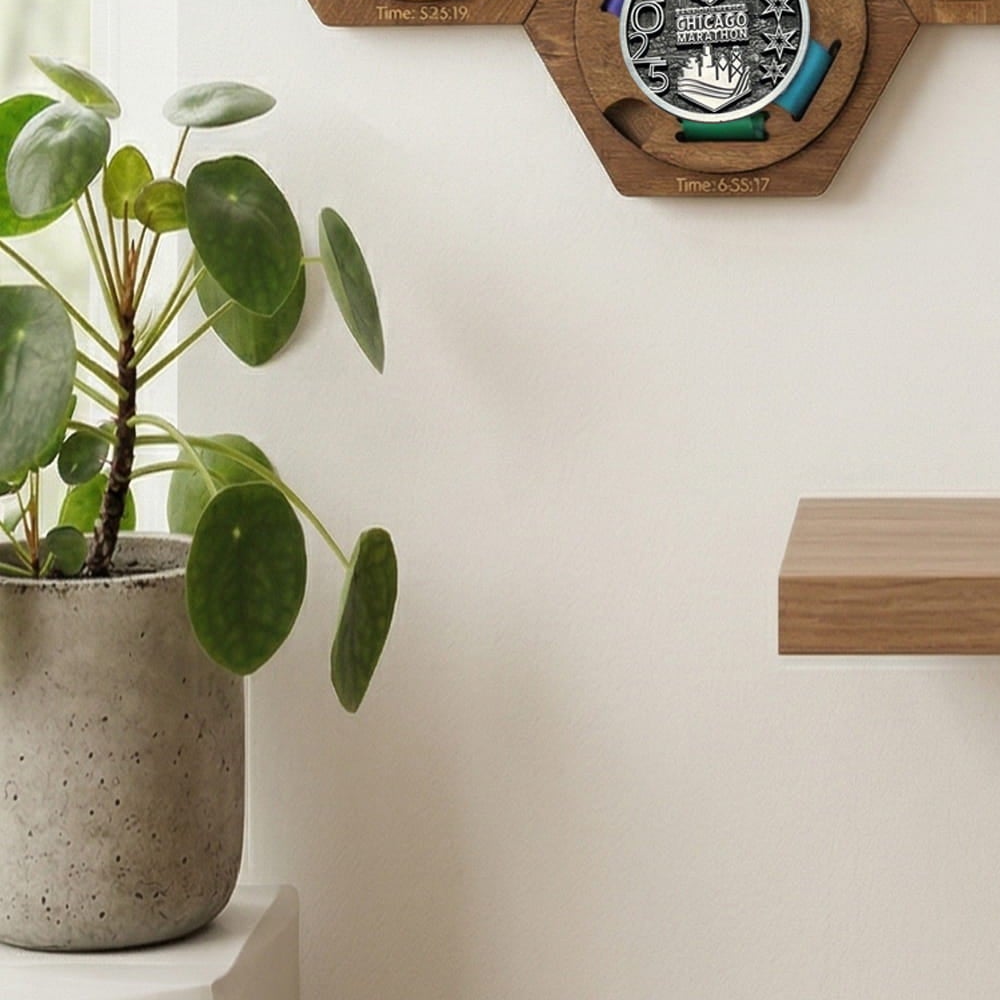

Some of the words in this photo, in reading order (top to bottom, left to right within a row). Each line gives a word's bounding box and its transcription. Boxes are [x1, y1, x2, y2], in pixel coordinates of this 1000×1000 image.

[376, 6, 416, 20] Time:
[676, 11, 748, 32] CHICAGO
[676, 28, 748, 43] MARATHON
